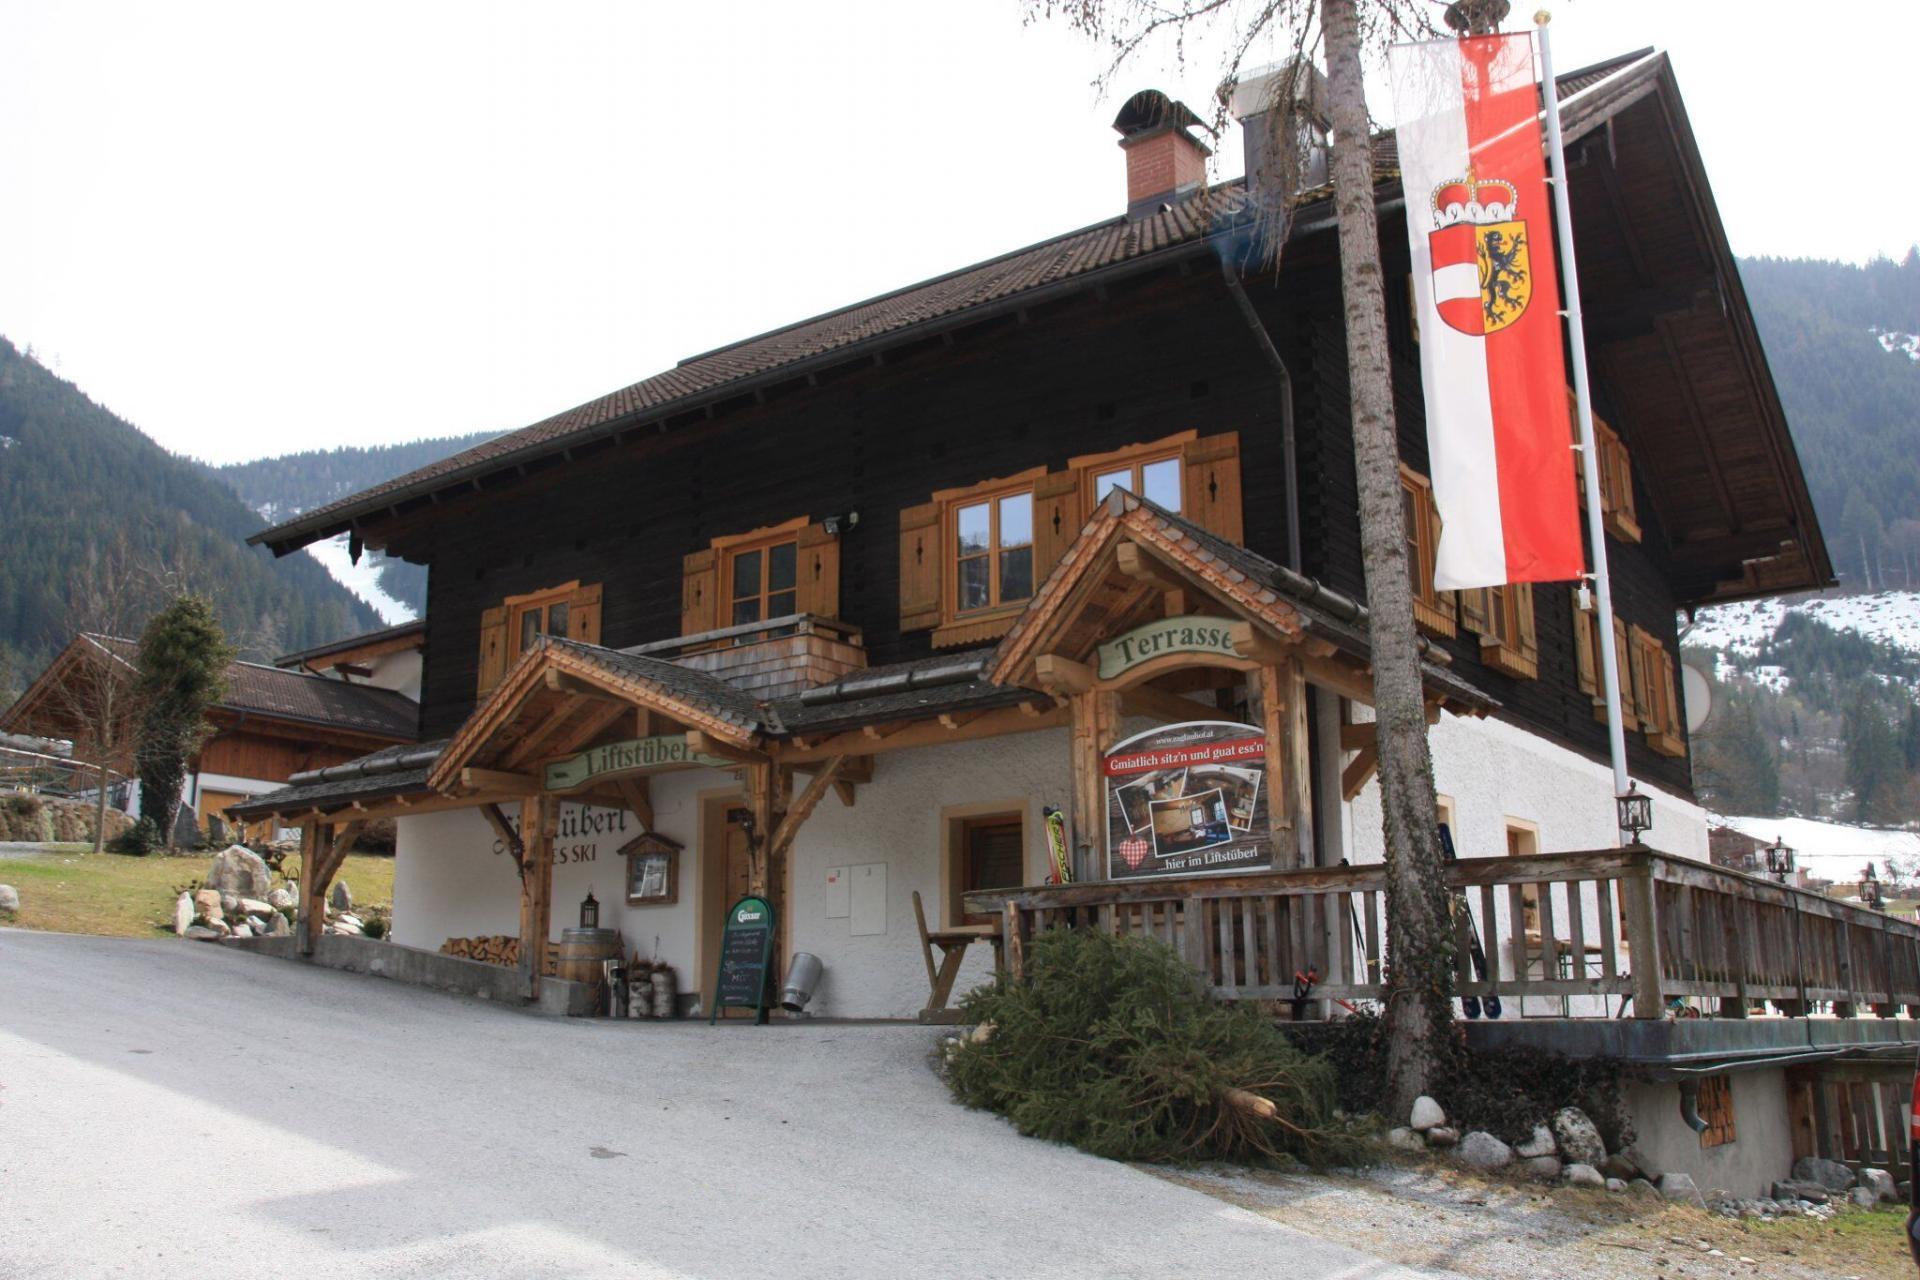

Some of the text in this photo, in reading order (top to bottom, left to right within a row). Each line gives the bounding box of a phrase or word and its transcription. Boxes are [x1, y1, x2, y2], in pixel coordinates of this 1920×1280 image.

[1115, 626, 1233, 664] Terrasse
[1110, 755, 1158, 771] Gmiatlich
[1190, 748, 1210, 761] und
[1212, 746, 1236, 759] guat
[572, 844, 597, 863] SKI
[1188, 856, 1202, 867] im
[1204, 847, 1258, 865] Liftstüberl
